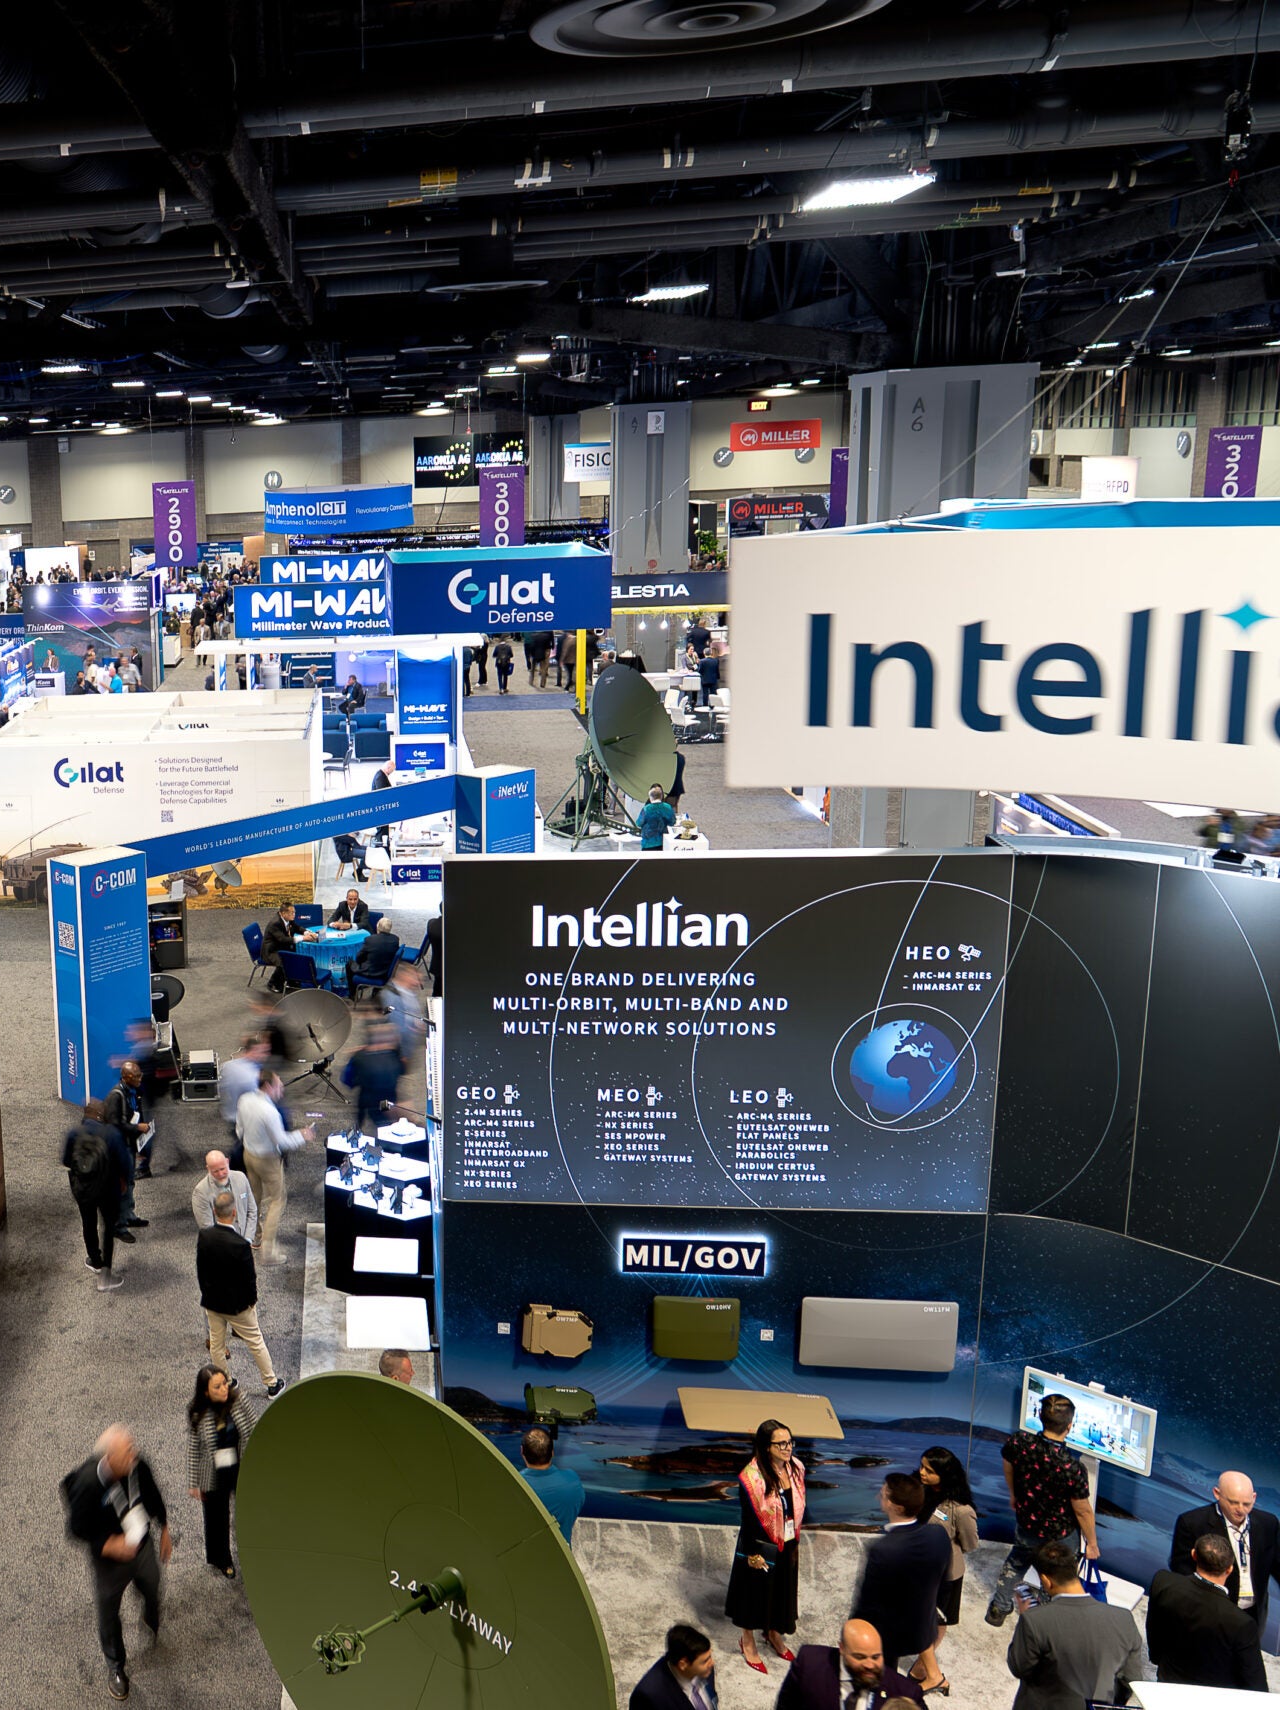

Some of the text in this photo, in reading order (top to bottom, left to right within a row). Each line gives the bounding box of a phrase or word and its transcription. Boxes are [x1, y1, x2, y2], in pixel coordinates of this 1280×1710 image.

[912, 397, 925, 413] A
[911, 417, 924, 431] 6
[1223, 433, 1255, 441] SATELLITE
[458, 454, 470, 464] AG
[512, 452, 523, 461] AG
[448, 569, 555, 614] Gilat
[488, 610, 554, 625] Defense
[26, 624, 64, 632] ThinKom
[252, 621, 303, 632] Millimeter
[309, 621, 342, 630] Wave
[191, 756, 222, 765] Designed
[54, 758, 124, 788] Gilat
[93, 786, 124, 794] Defense
[159, 780, 188, 788] Leverage
[498, 781, 529, 799] iNetVu
[160, 788, 202, 796] Technologies
[214, 788, 233, 796] Rapid
[185, 841, 214, 854] WORLD'S
[216, 835, 243, 847] LEADING
[245, 825, 293, 841] MANUFACTURER
[305, 814, 345, 828] AUTO-AQUIRE
[346, 808, 373, 820] ANTENNA
[375, 801, 400, 813] SYSTEMS
[55, 872, 74, 886] C-COM
[95, 868, 136, 891] C-COM
[532, 897, 748, 948] Intellian
[905, 945, 950, 961] HEO
[525, 973, 755, 986] ONE BRAND DELIVERING
[955, 972, 992, 980] SERIES
[912, 983, 981, 991] INMARSAT GX
[493, 997, 788, 1013] MULTI-ORBIT, MULTI-BAND AND
[503, 1021, 776, 1036] MULTI-NETWORK SOLUTIONS
[456, 1086, 496, 1100] GEO
[597, 1088, 640, 1102] MEO
[729, 1090, 769, 1104] LEO
[490, 1109, 522, 1117] SERIES
[502, 1120, 535, 1128] SERIES
[464, 1130, 507, 1138] E-SERIES
[464, 1149, 549, 1158] FLEETBROADBAND
[604, 1154, 693, 1163] GATEWAY SYSTEMS
[735, 1152, 795, 1160] PARABOLICS
[777, 1163, 815, 1171] CERTUS
[625, 1244, 762, 1272] MIL/GOV
[439, 1601, 512, 1655] LYAWAY
